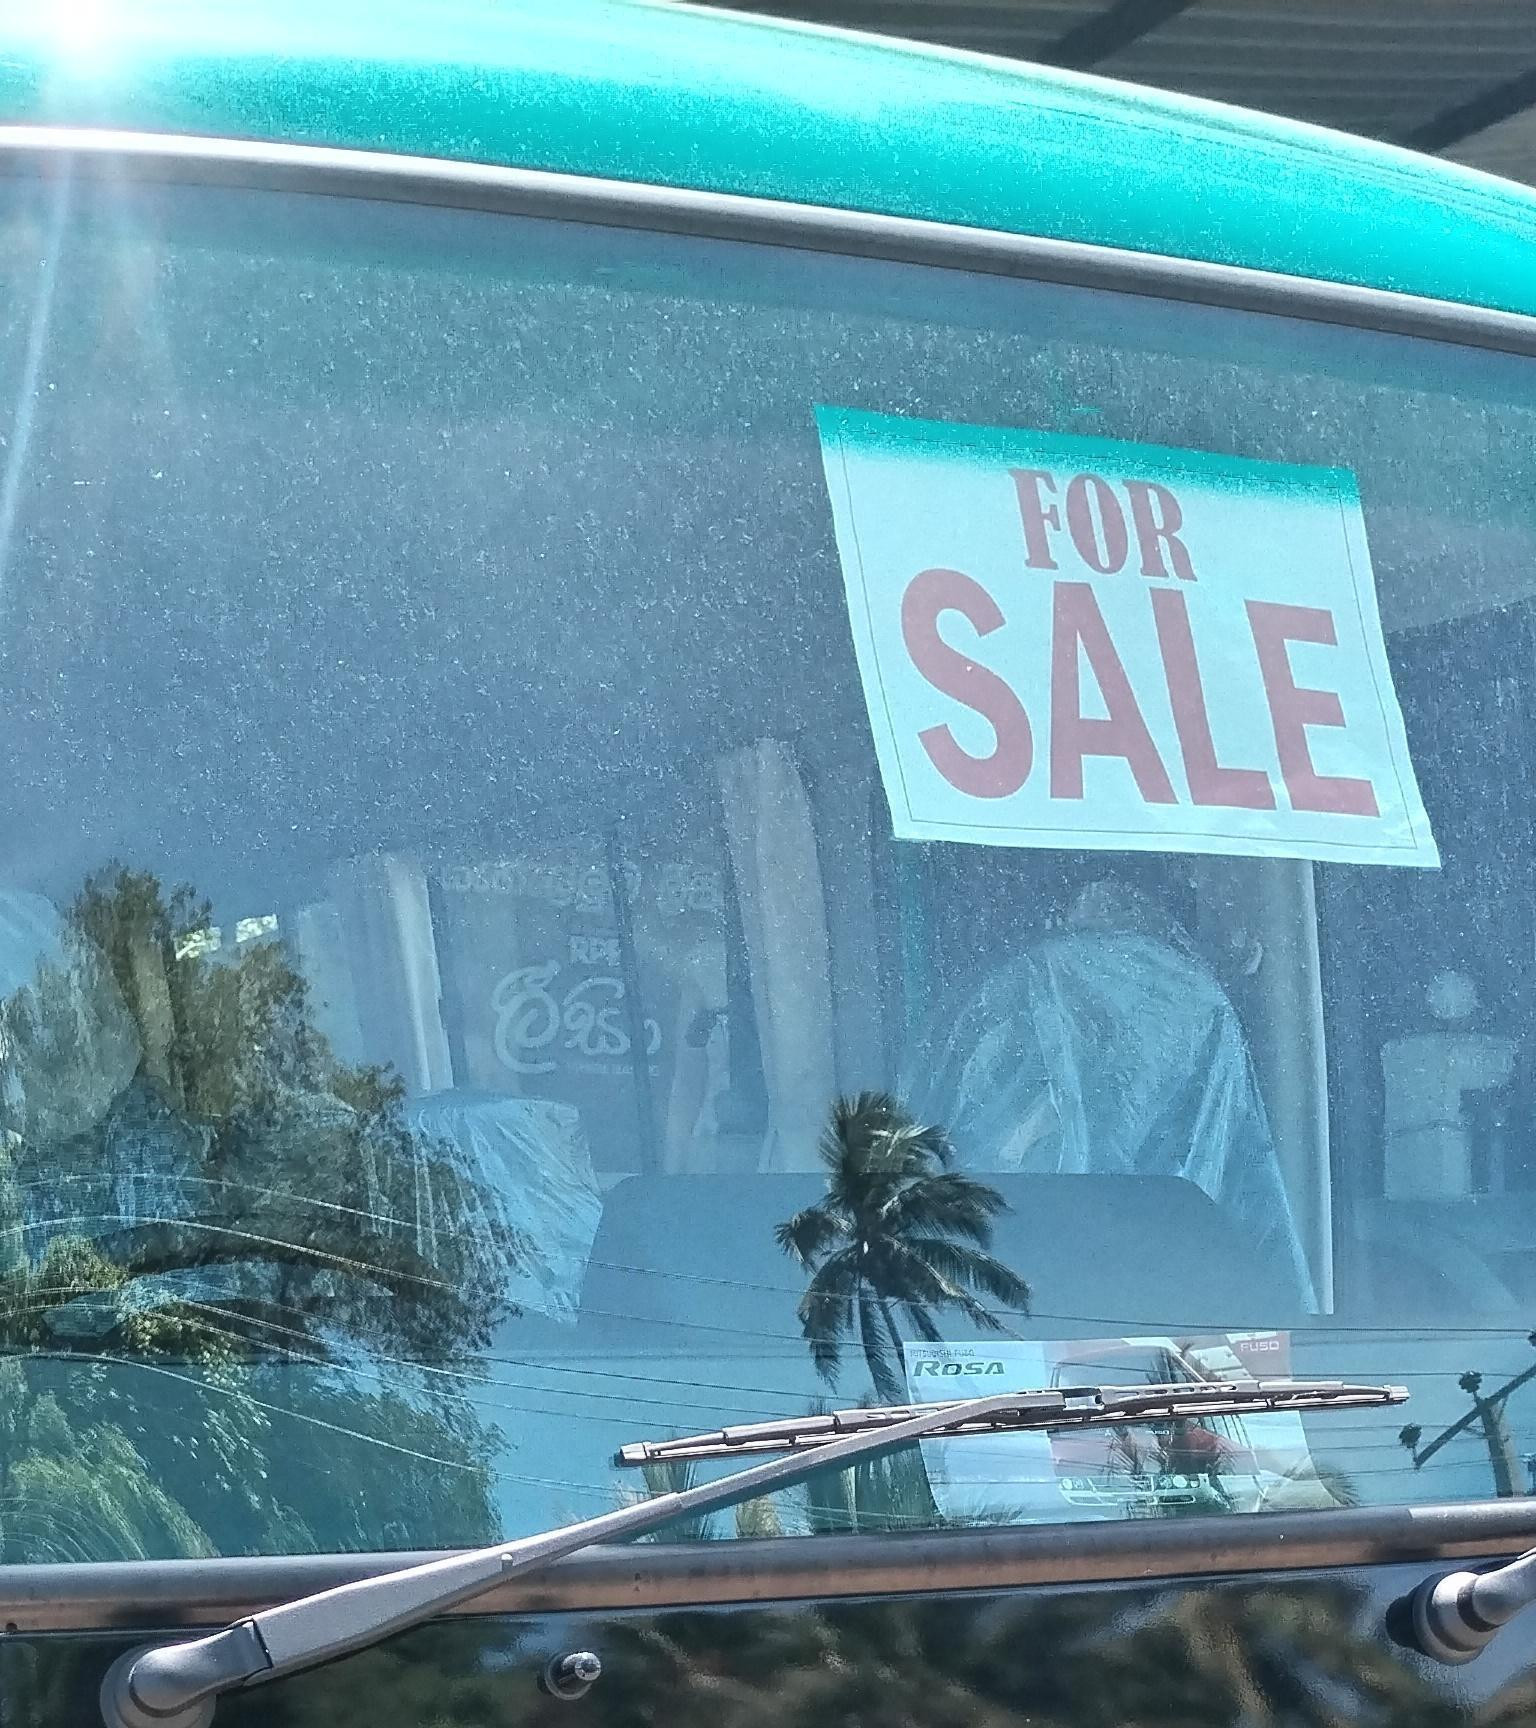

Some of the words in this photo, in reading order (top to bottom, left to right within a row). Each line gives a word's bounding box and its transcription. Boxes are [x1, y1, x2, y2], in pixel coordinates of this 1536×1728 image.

[1008, 467, 1198, 582] FOR
[901, 567, 1381, 817] SALE
[1240, 1340, 1280, 1352] FUSO
